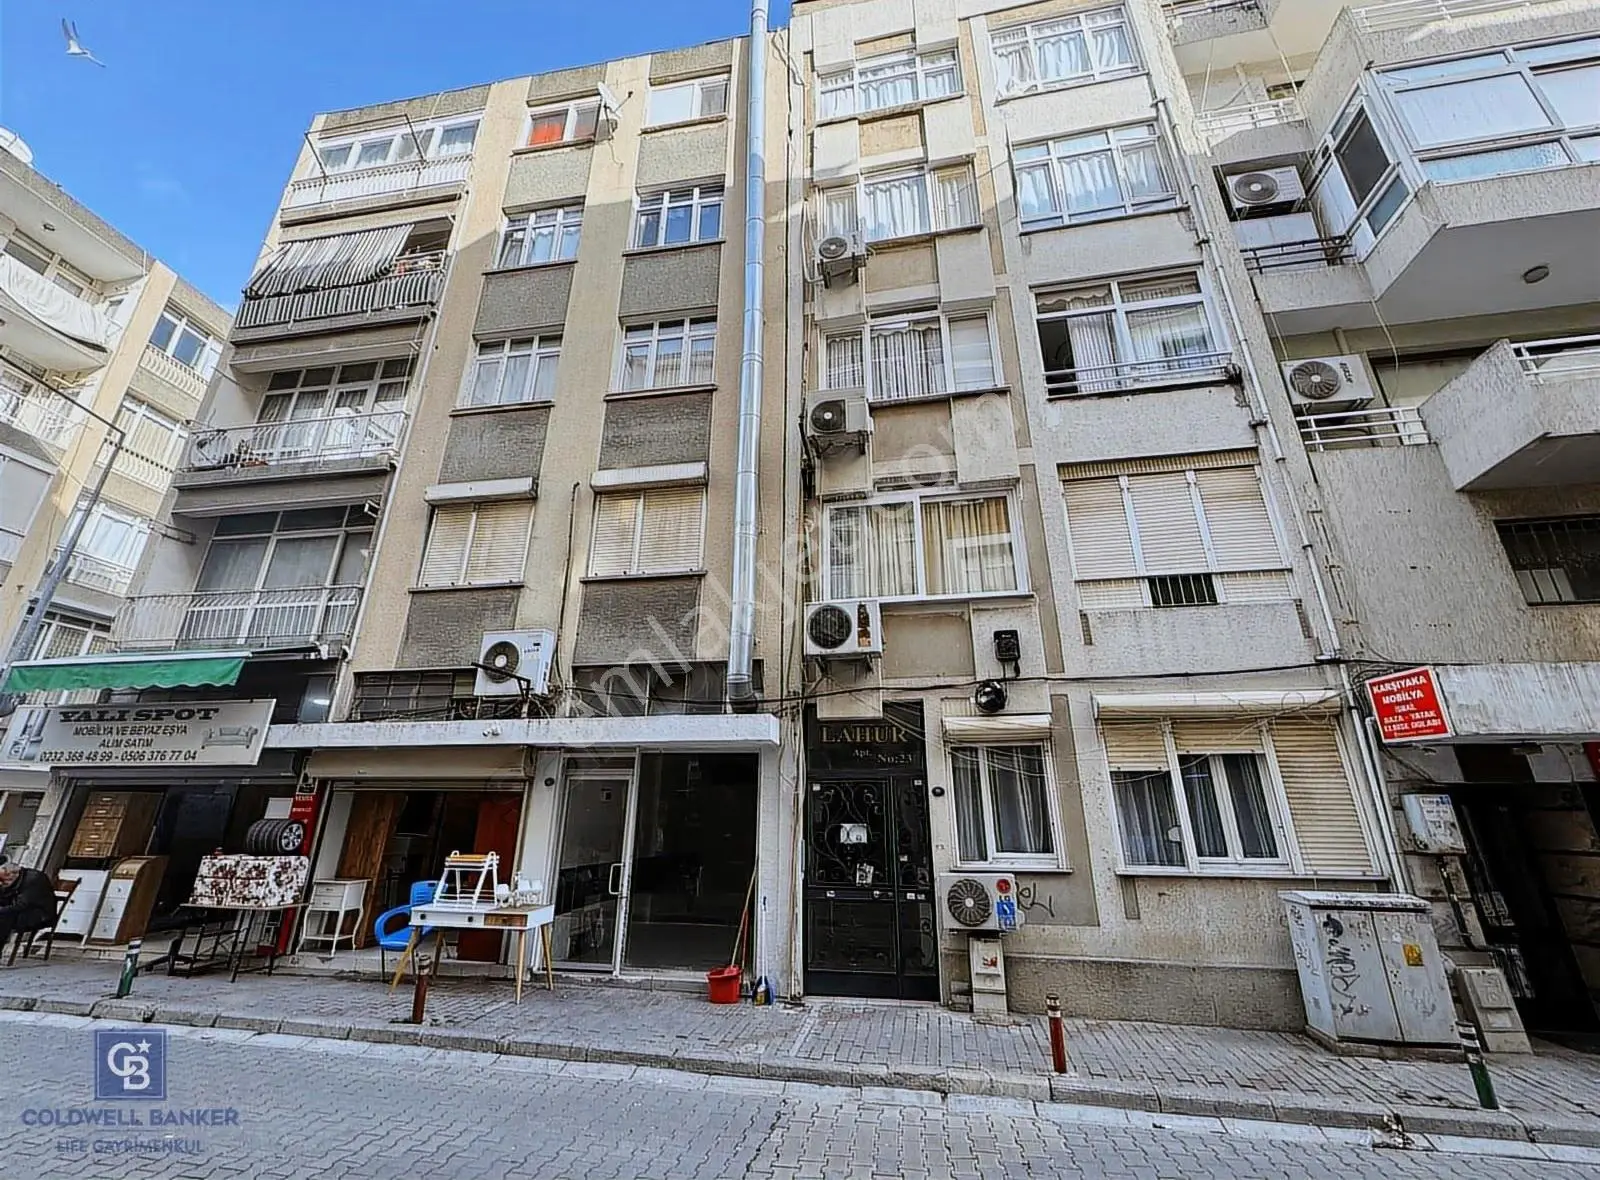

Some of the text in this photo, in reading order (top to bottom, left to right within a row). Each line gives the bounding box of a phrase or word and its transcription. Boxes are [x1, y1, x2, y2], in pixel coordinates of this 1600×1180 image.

[1372, 675, 1428, 695] KARŞIYAKA
[1382, 690, 1425, 705] MOBİLYA
[59, 707, 220, 723] YALI SPOT
[73, 723, 187, 737] MOBİLYA VE BEYAZ EŞYA
[820, 725, 908, 744] LAHUR
[99, 738, 154, 748] ALIM SATIM
[40, 752, 64, 762] 0232
[100, 751, 113, 761] 99
[121, 751, 147, 761] 0506
[149, 750, 166, 761] 376
[168, 750, 182, 761] 77
[184, 750, 198, 761] 04
